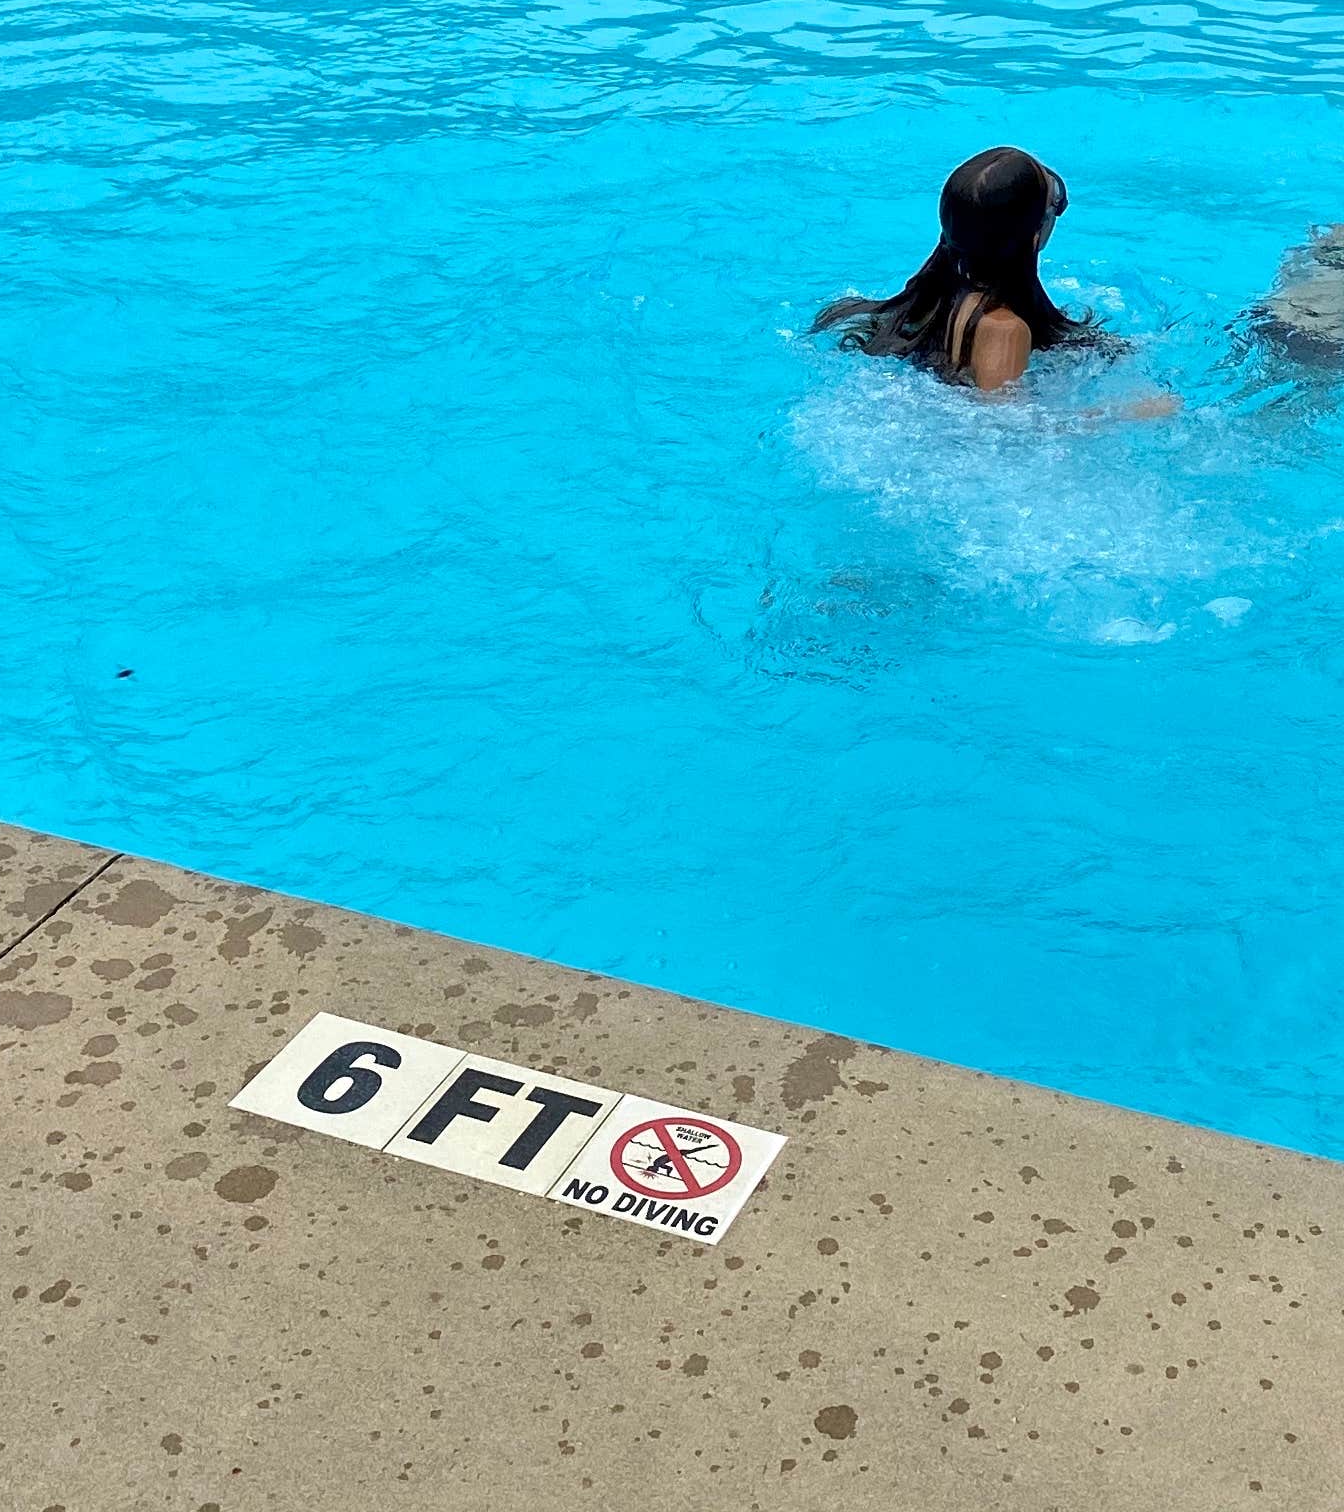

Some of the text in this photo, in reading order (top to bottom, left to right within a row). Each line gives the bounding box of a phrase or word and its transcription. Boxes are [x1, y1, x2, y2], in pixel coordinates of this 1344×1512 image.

[296, 1041, 604, 1171] 6 FT
[676, 1126, 712, 1140] SHALLOW
[676, 1133, 703, 1144] WATER
[561, 1178, 719, 1236] NO DIVING
